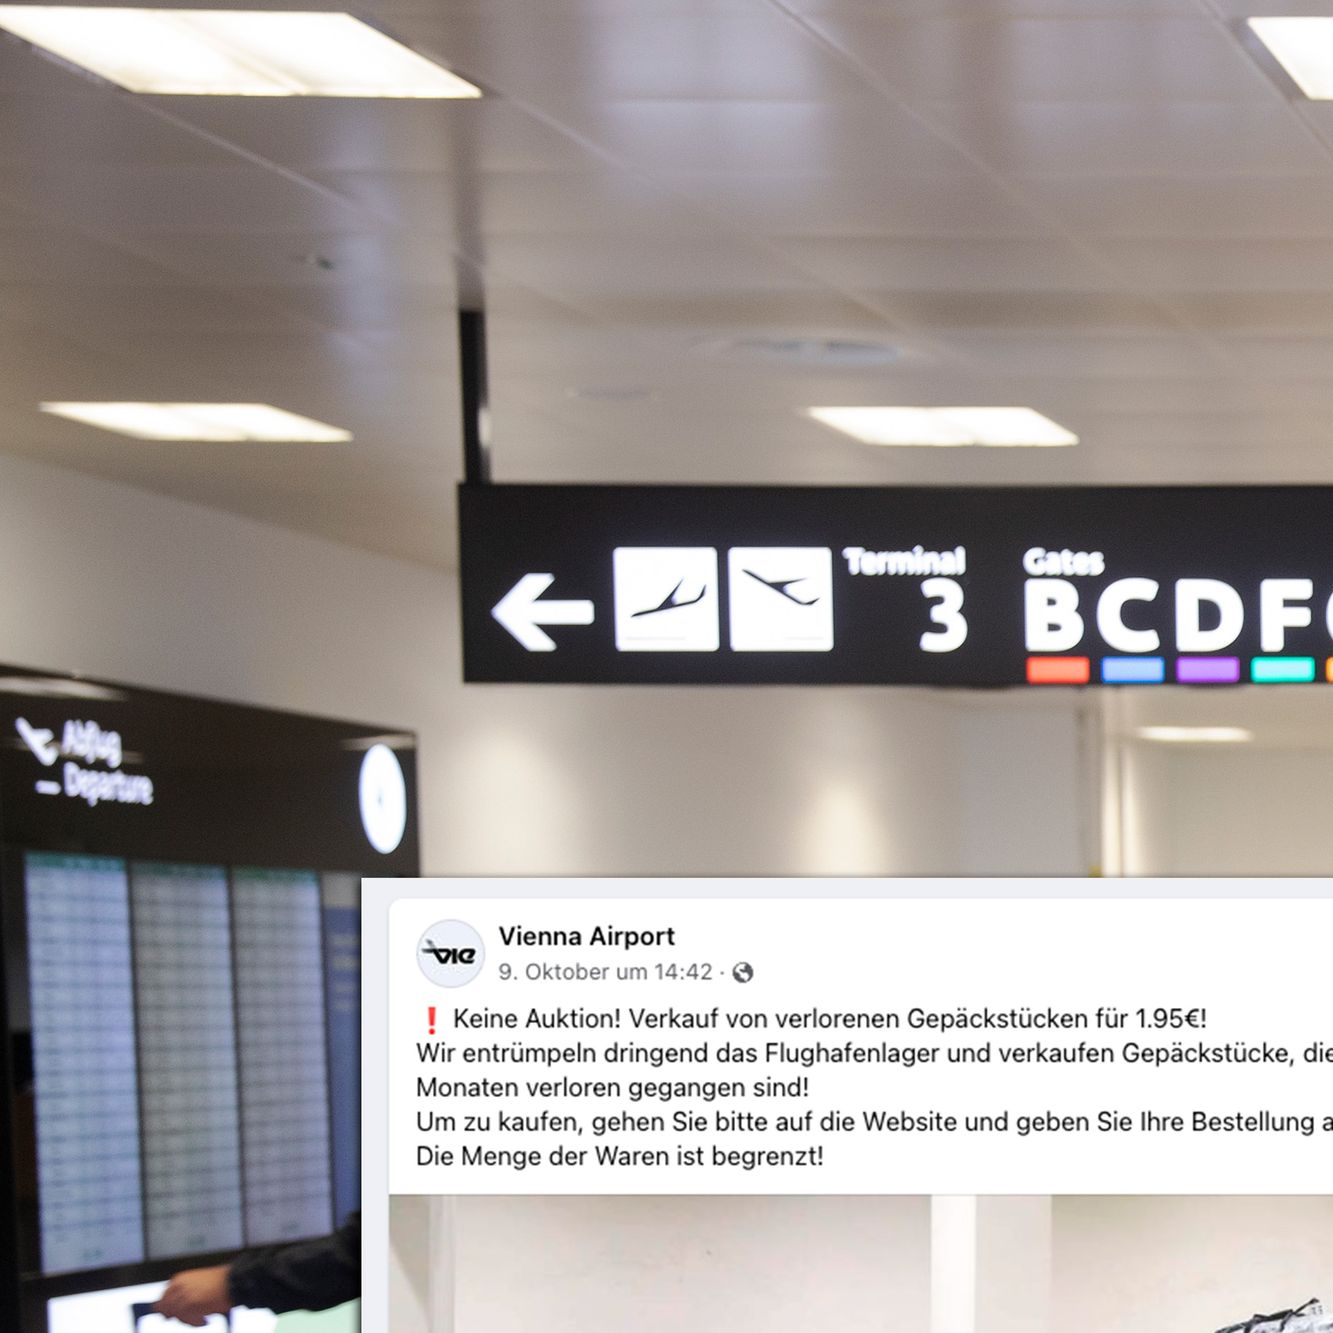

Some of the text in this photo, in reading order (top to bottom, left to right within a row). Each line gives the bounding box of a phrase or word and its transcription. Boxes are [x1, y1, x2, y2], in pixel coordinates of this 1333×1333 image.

[842, 544, 967, 576] Terminal
[1022, 547, 1106, 577] Gates
[919, 577, 968, 653] 3
[64, 761, 154, 807] Departure
